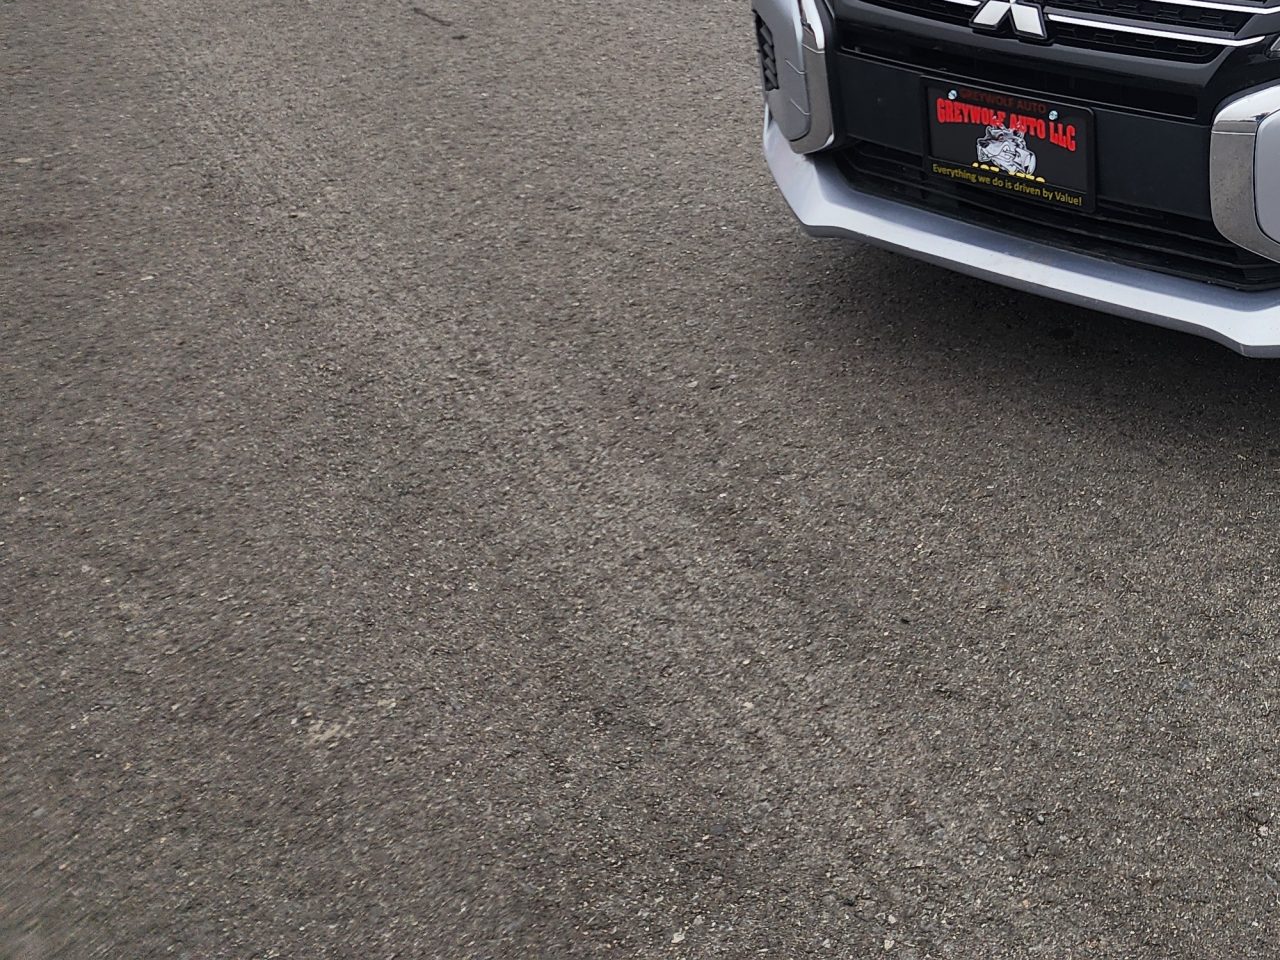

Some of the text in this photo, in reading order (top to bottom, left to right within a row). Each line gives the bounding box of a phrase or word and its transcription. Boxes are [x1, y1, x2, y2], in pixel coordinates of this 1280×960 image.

[936, 98, 1077, 152] GREYWOLF AUTO LLC
[932, 164, 977, 183] Everything
[978, 175, 991, 185] we
[992, 176, 1004, 188] do
[1005, 179, 1012, 189] is
[1014, 182, 1041, 196] driven
[1043, 188, 1054, 200] by
[1054, 191, 1082, 206] Value!
